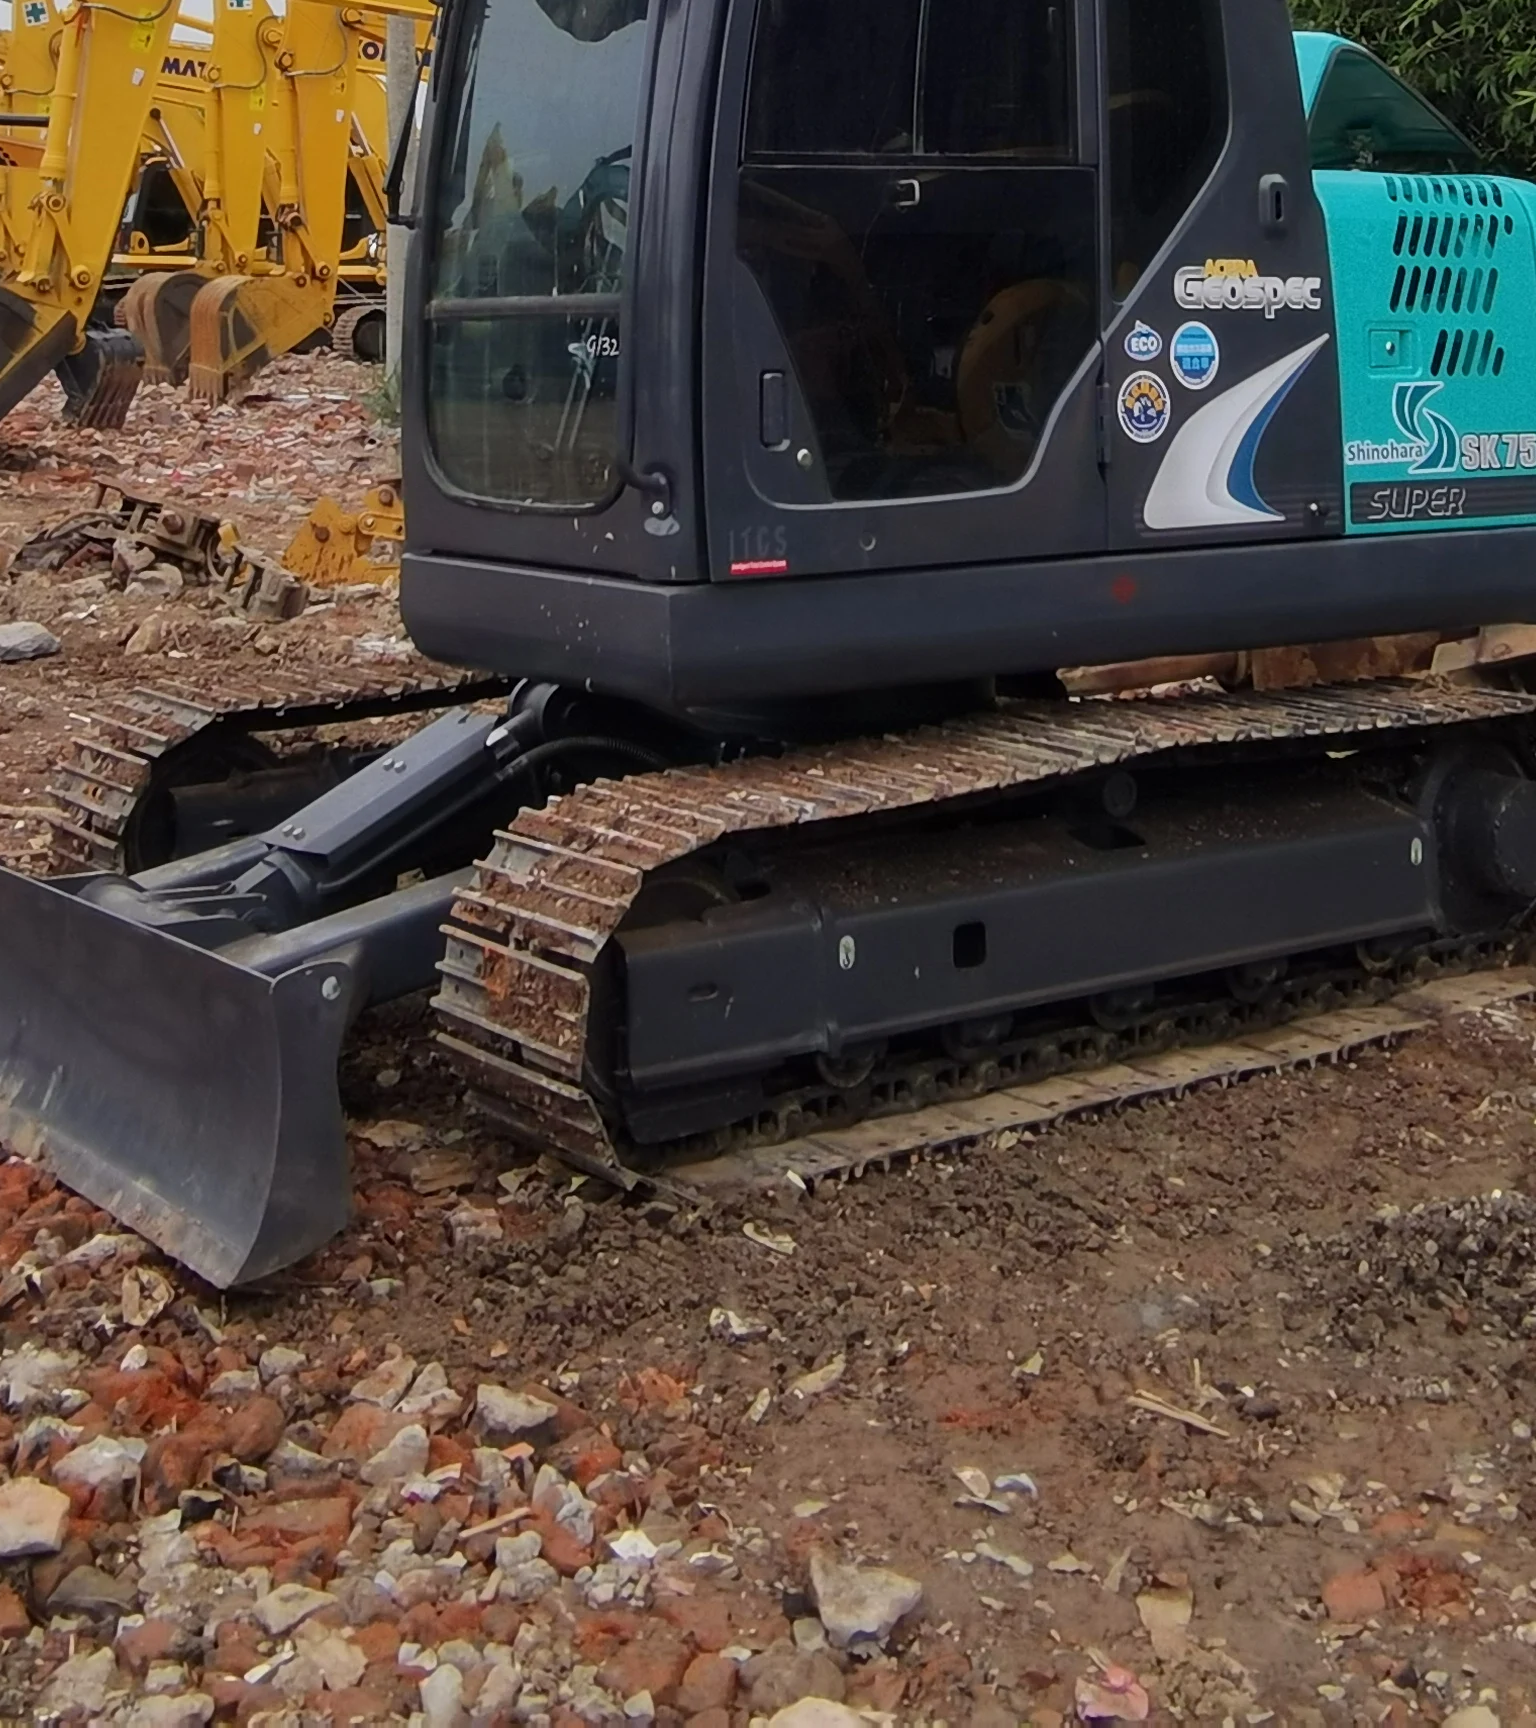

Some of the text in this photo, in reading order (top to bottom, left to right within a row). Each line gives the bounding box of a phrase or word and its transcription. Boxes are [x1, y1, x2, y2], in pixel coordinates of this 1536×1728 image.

[1130, 336, 1158, 352] ECO
[1347, 440, 1424, 463] Shinohara
[1367, 485, 1467, 520] SUPER
